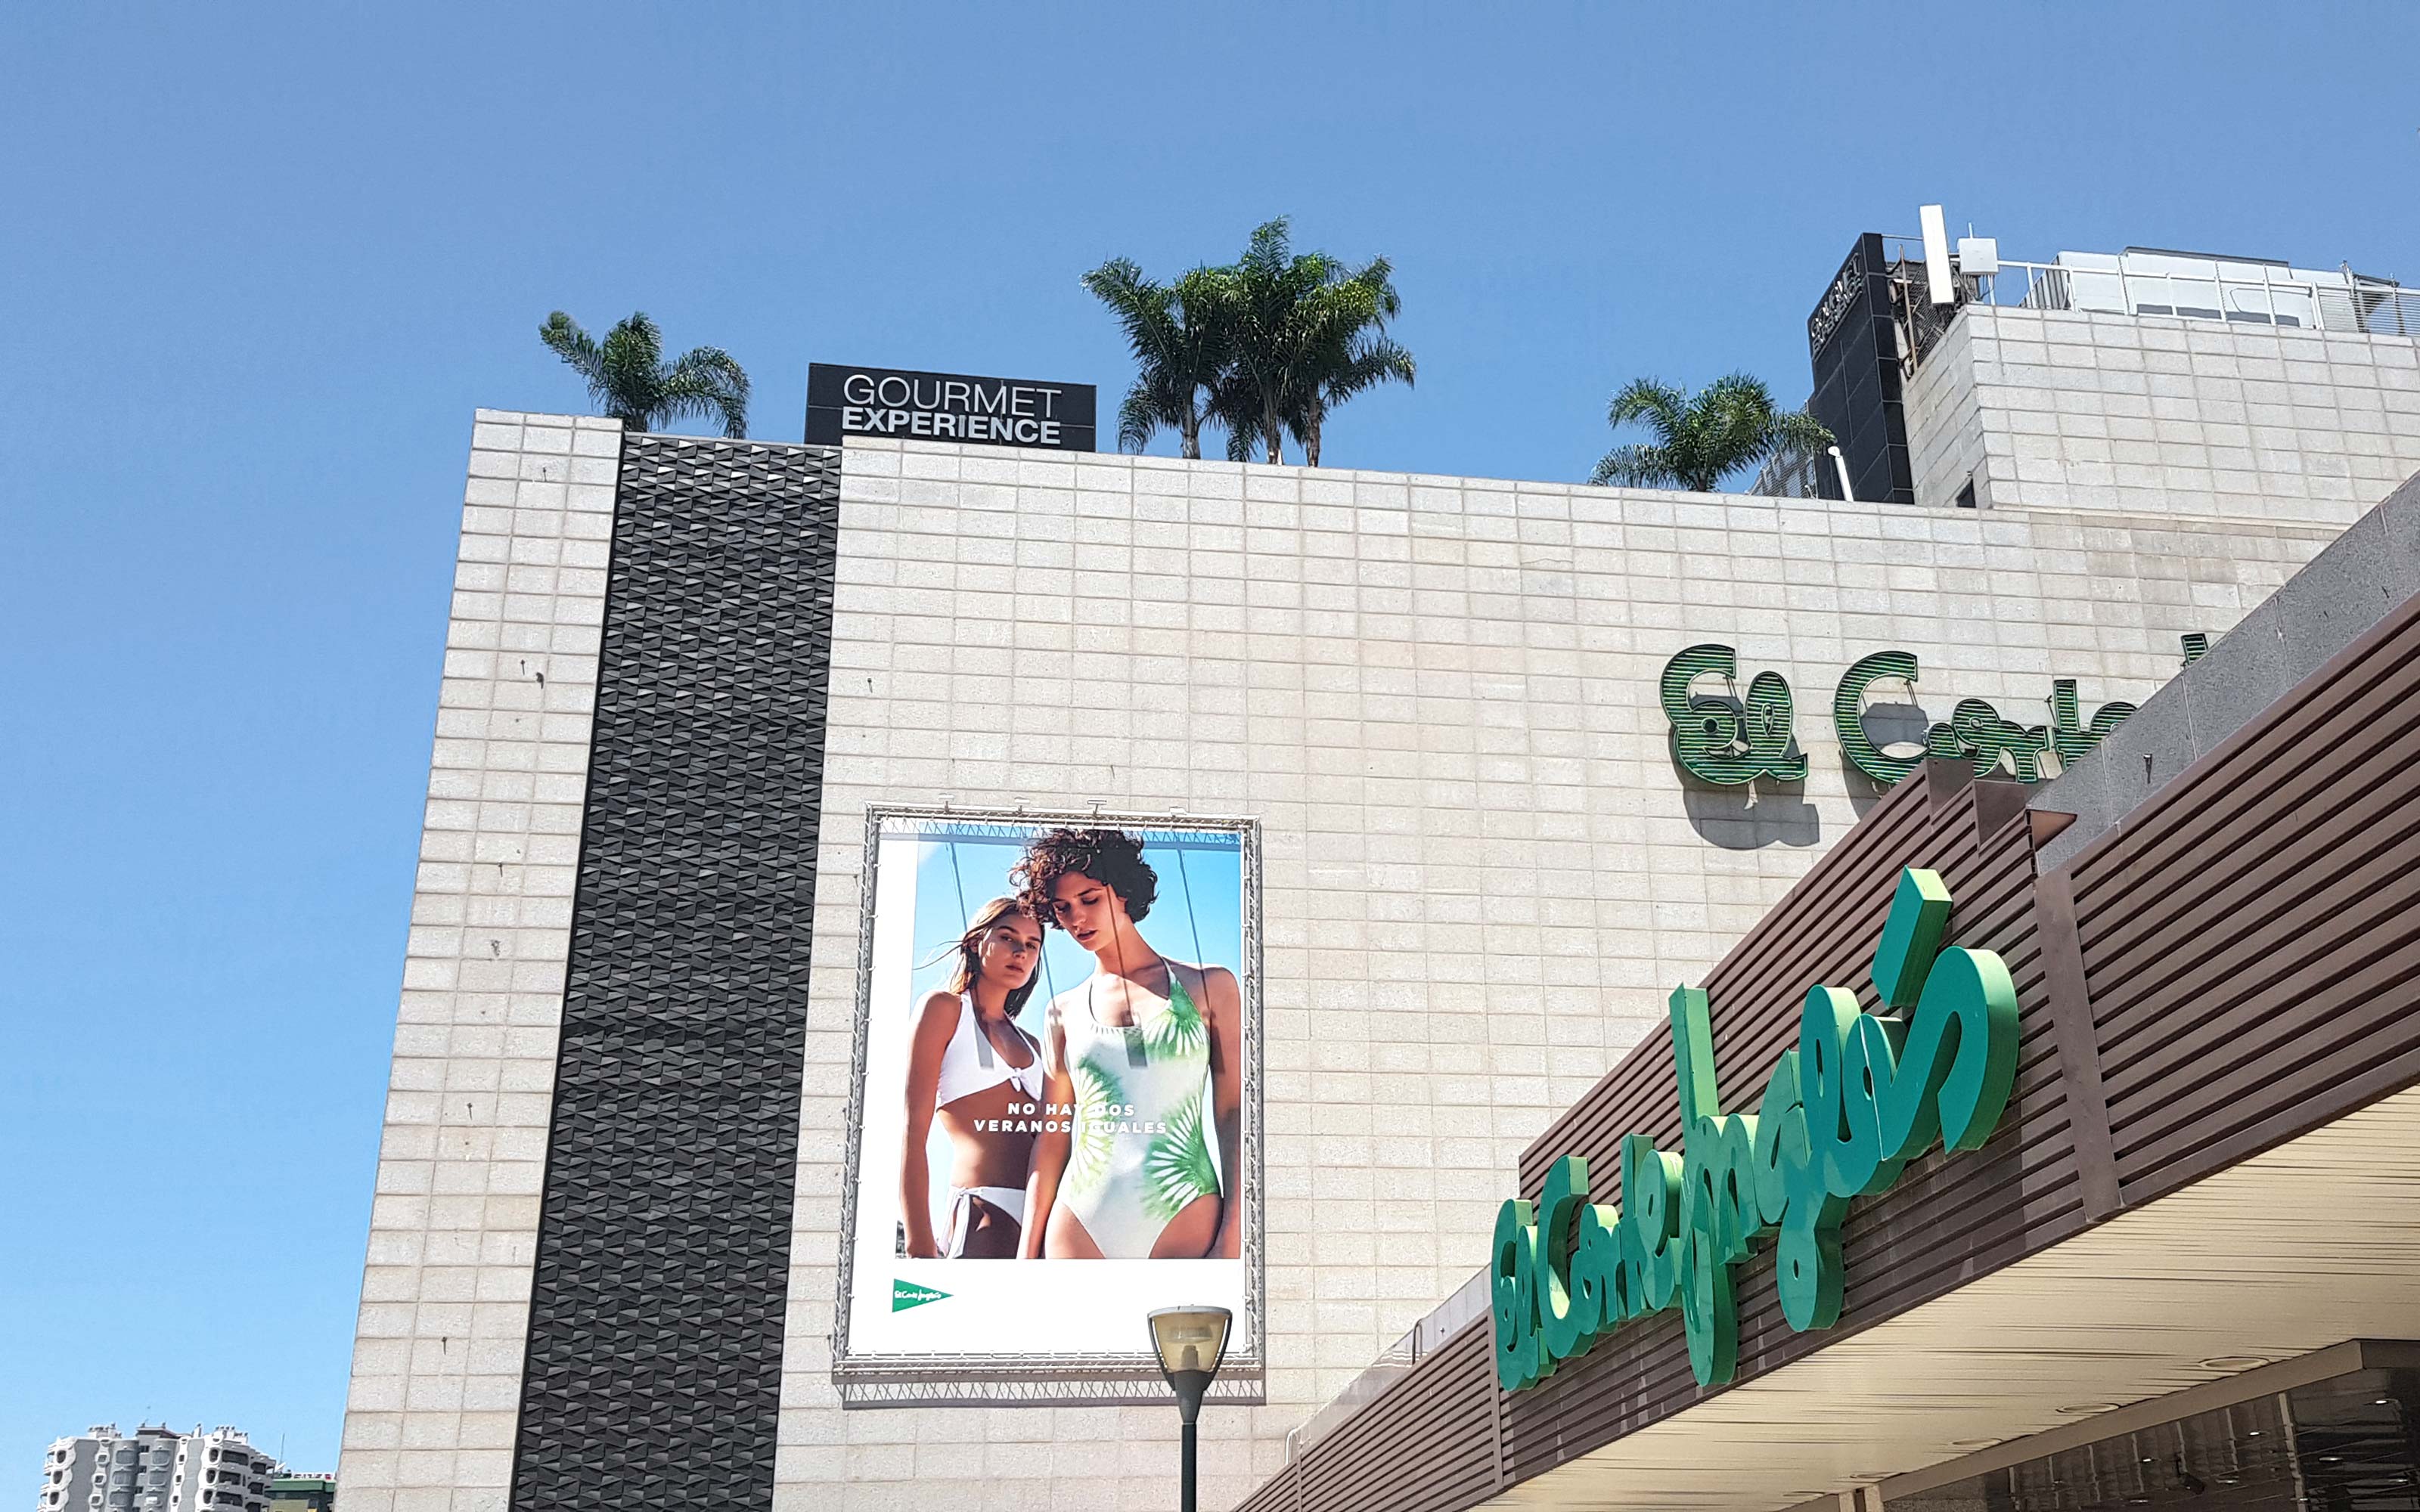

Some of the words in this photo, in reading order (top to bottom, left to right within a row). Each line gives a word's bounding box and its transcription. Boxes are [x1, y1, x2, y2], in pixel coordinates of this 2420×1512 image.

[843, 374, 1062, 417] GOURMET
[842, 407, 1061, 444] EXPERIENCE
[1660, 644, 1807, 785] El
[974, 1120, 1072, 1132] VERANOS
[1081, 1121, 1167, 1134] IGUALES
[1008, 1103, 1036, 1115] NO
[1094, 1104, 1134, 1116] DOS
[1491, 1198, 1556, 1391] El
[1537, 1154, 1684, 1359] Corte
[1669, 865, 2018, 1387] Inglés
